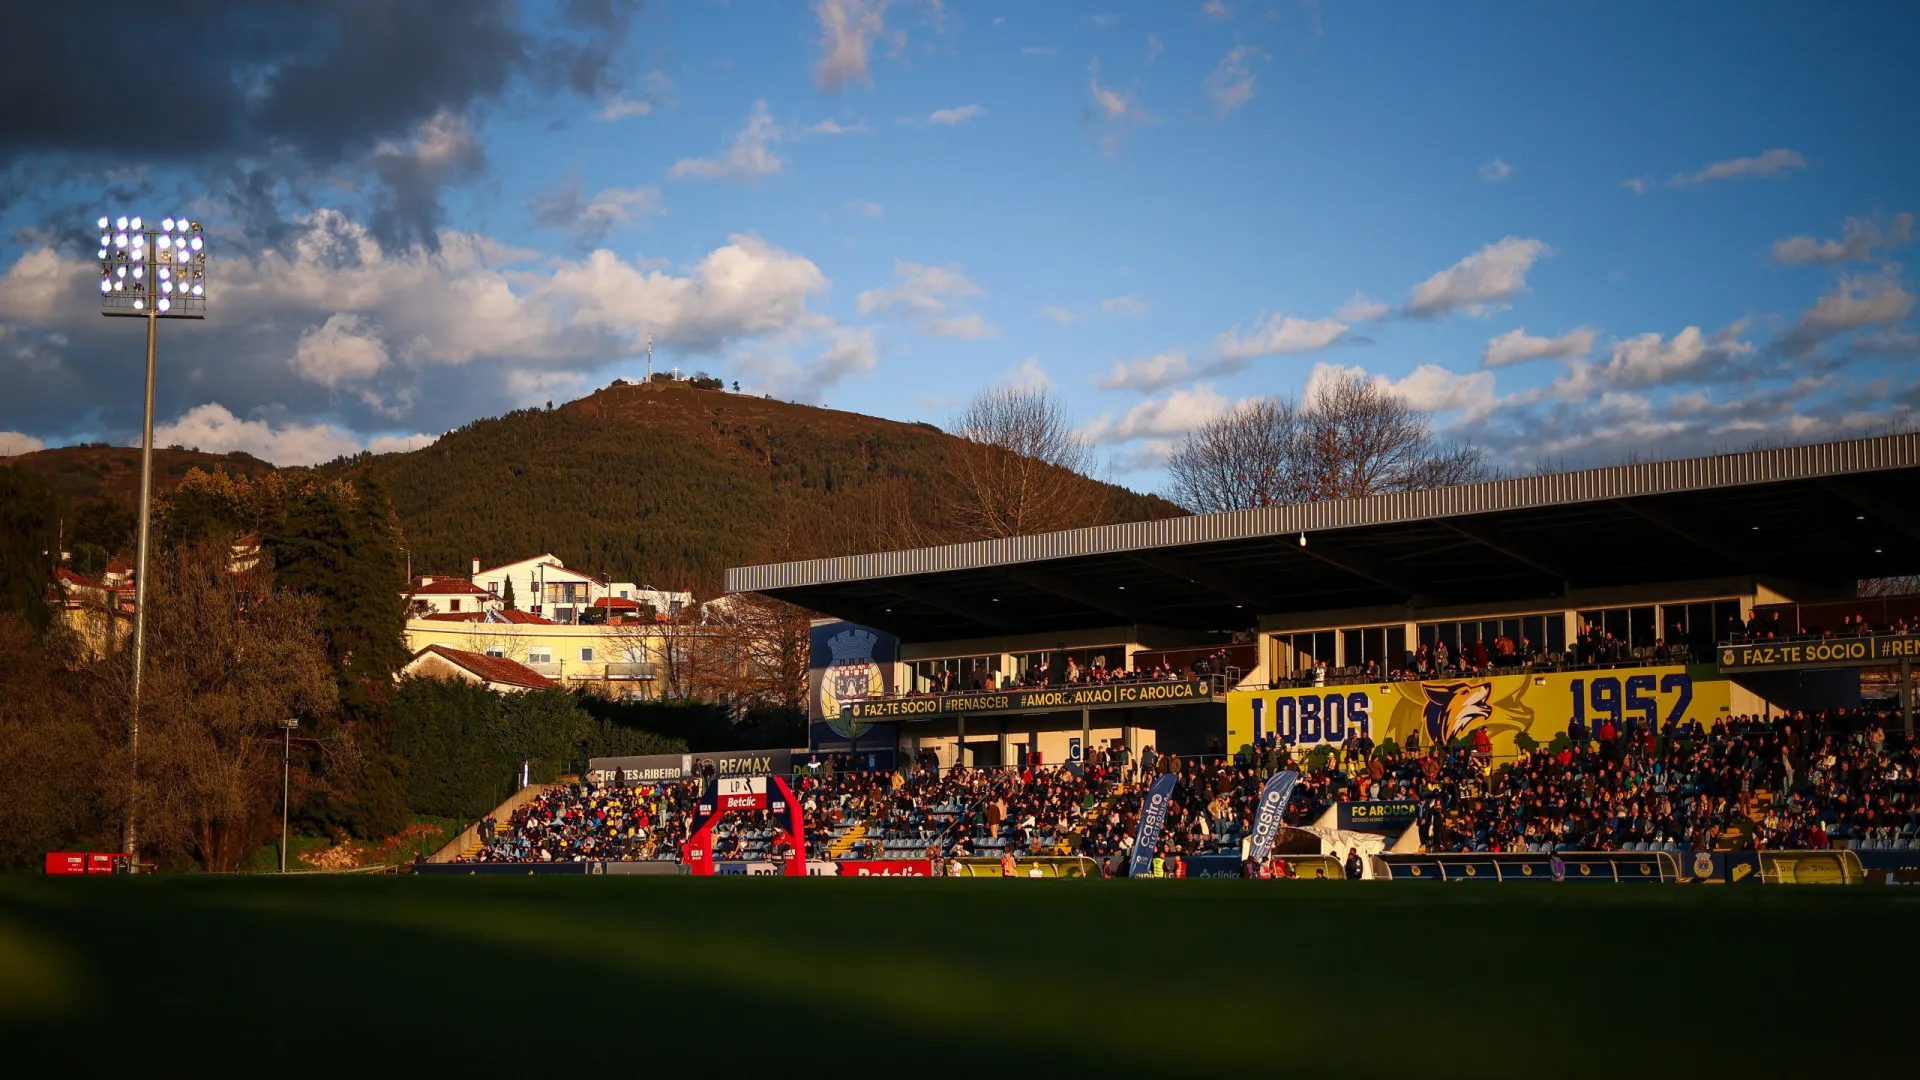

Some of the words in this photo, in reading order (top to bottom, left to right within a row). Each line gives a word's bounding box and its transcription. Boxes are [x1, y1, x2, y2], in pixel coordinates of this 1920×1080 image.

[1743, 647, 1801, 664] FAZ-TE
[1805, 641, 1866, 661] SÓCIO
[864, 702, 899, 717] FAZ-TE
[901, 698, 937, 713] SÓCIO
[945, 696, 1009, 711] #RENASCER
[1120, 687, 1137, 700] FC
[1139, 684, 1194, 699] AROUCA
[1570, 674, 1693, 740] 1952
[1252, 692, 1370, 748] LOBOS
[605, 767, 681, 781] FOTES&RIBEIRO
[719, 757, 771, 774] RE/MAX
[727, 796, 756, 807] Betclic
[1351, 805, 1367, 817] FC
[1369, 803, 1416, 816] AROUCA
[1141, 794, 1163, 847] castro
[1253, 791, 1281, 847] castro
